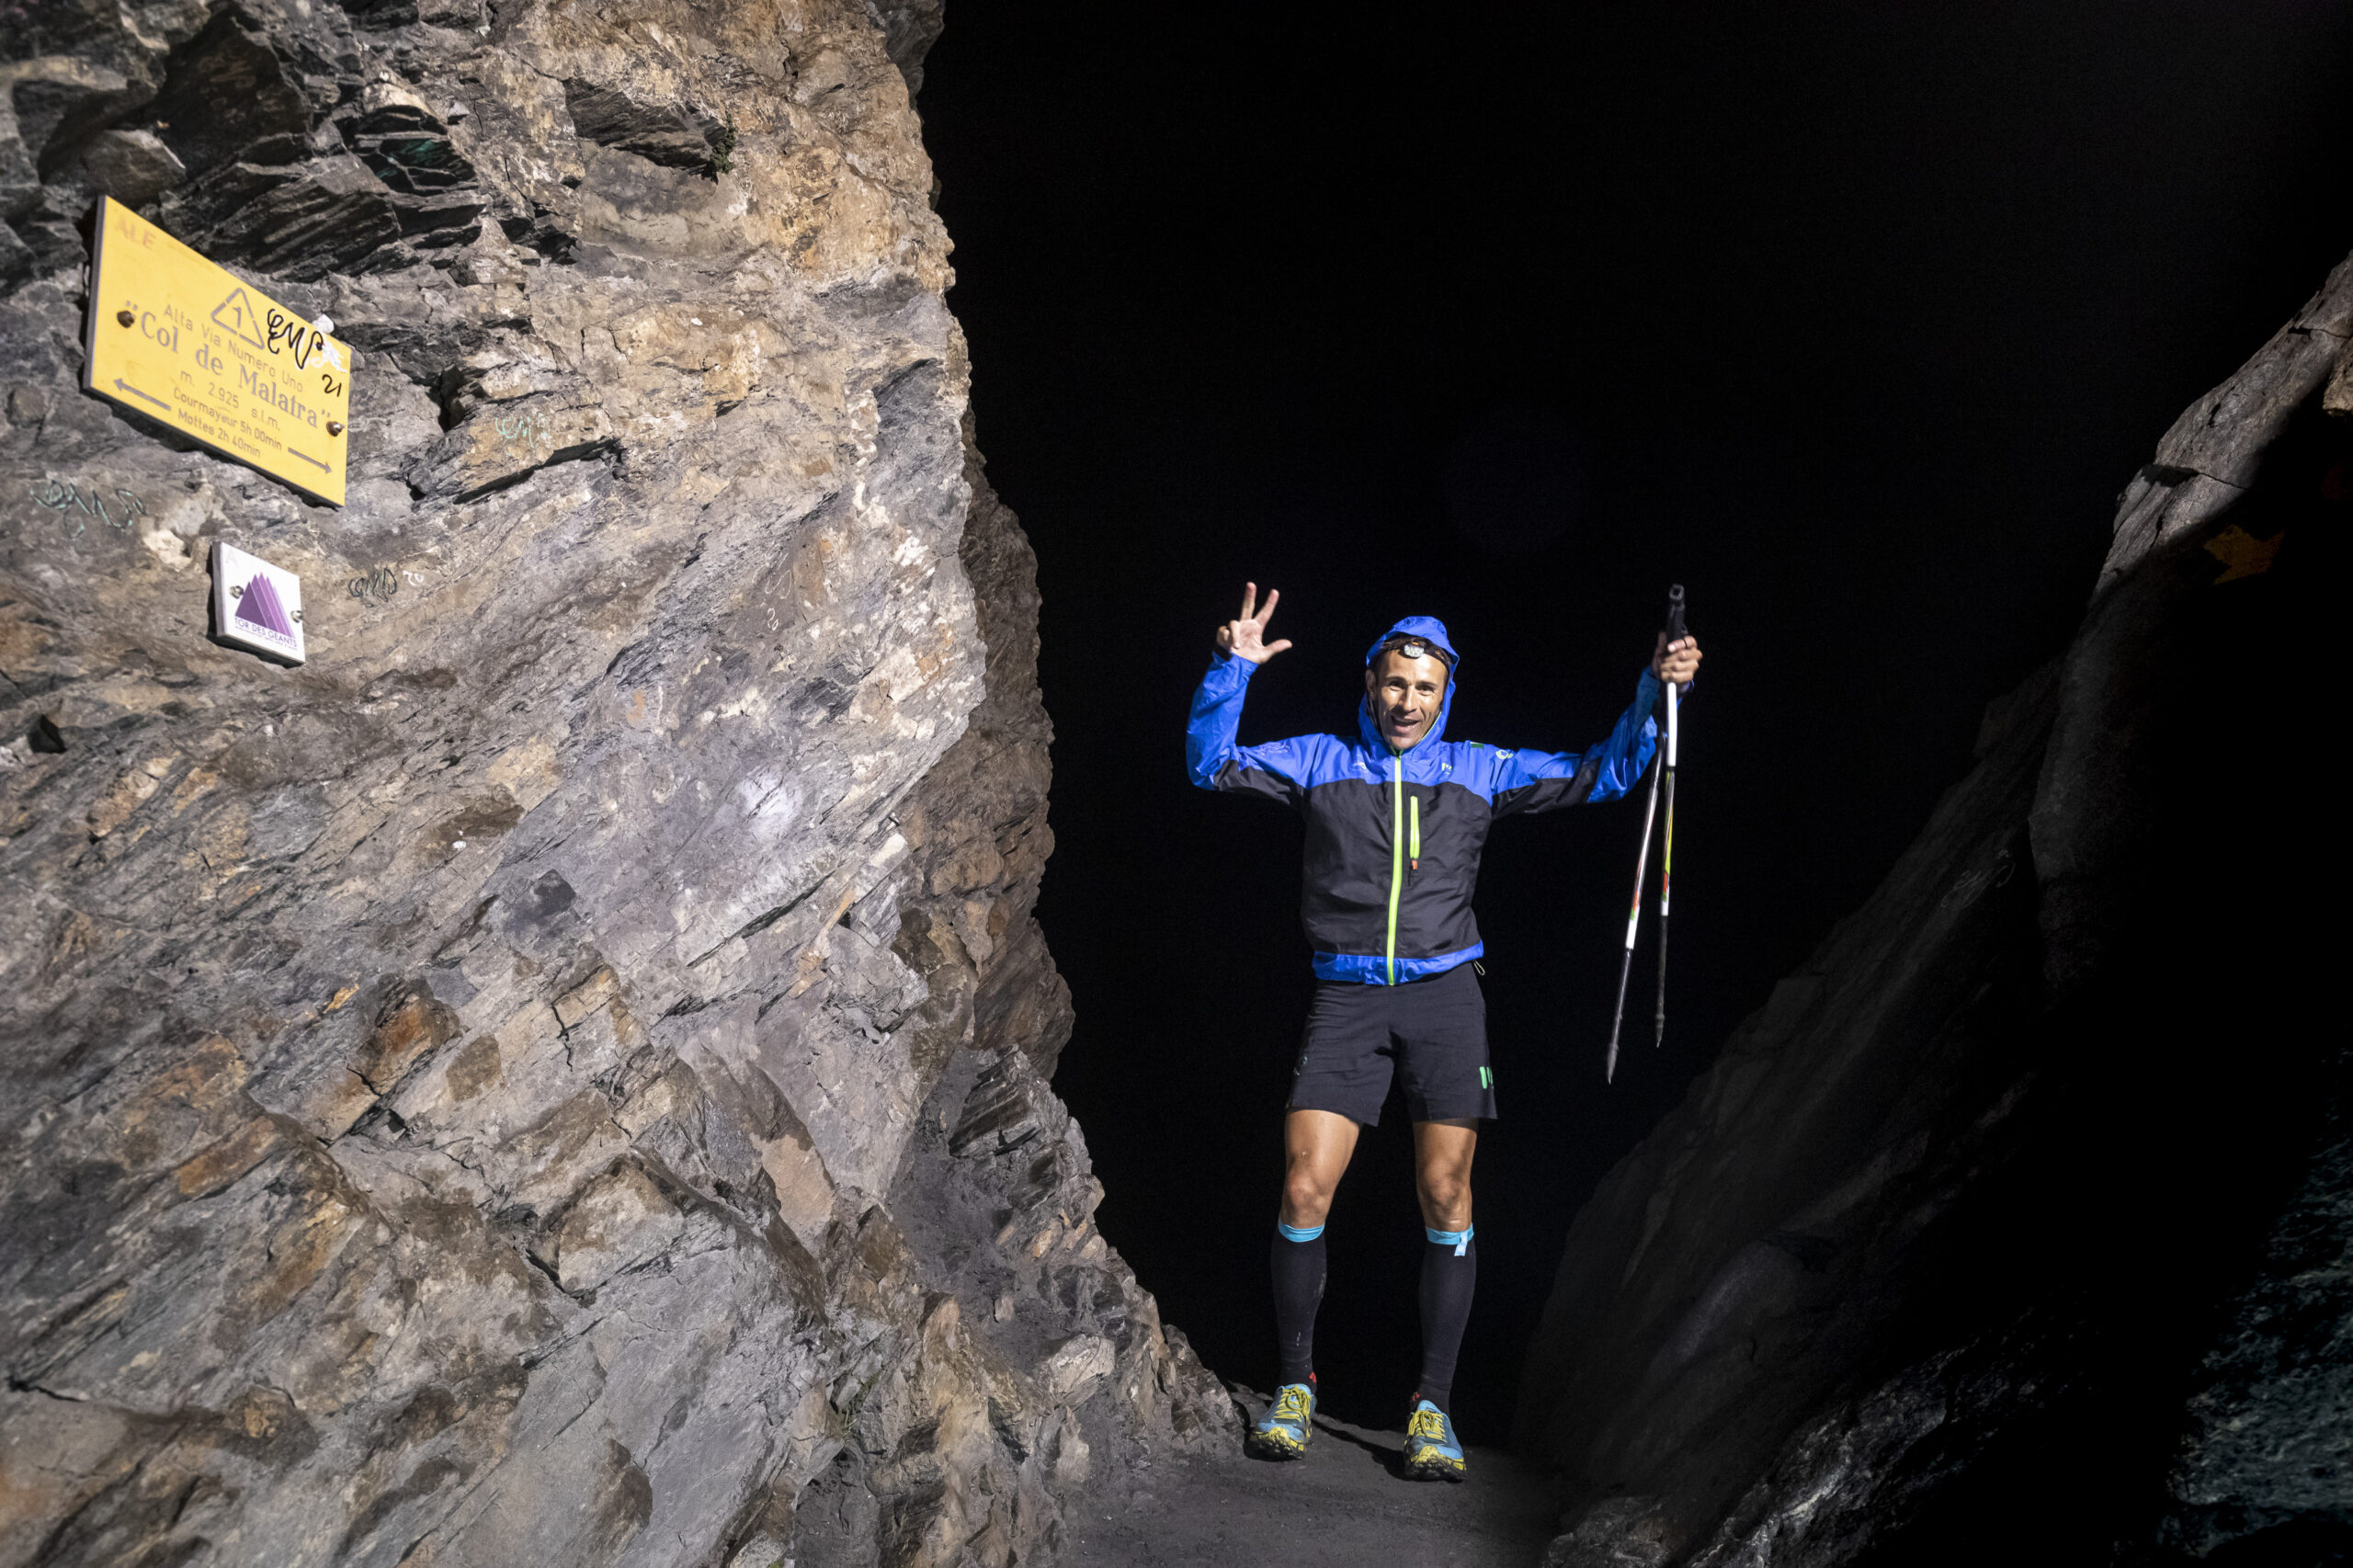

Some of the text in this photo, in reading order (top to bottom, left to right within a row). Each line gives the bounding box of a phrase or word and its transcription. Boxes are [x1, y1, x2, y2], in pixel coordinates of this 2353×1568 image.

[164, 303, 303, 392] Alta Via Numero Uno
[195, 343, 223, 376] de
[174, 386, 283, 451] Courmayeur 5h 00min
[177, 407, 261, 458] Mottes 2h 40min
[235, 617, 249, 628] TOR
[252, 624, 266, 635] DES
[267, 631, 297, 647] GEANTS
